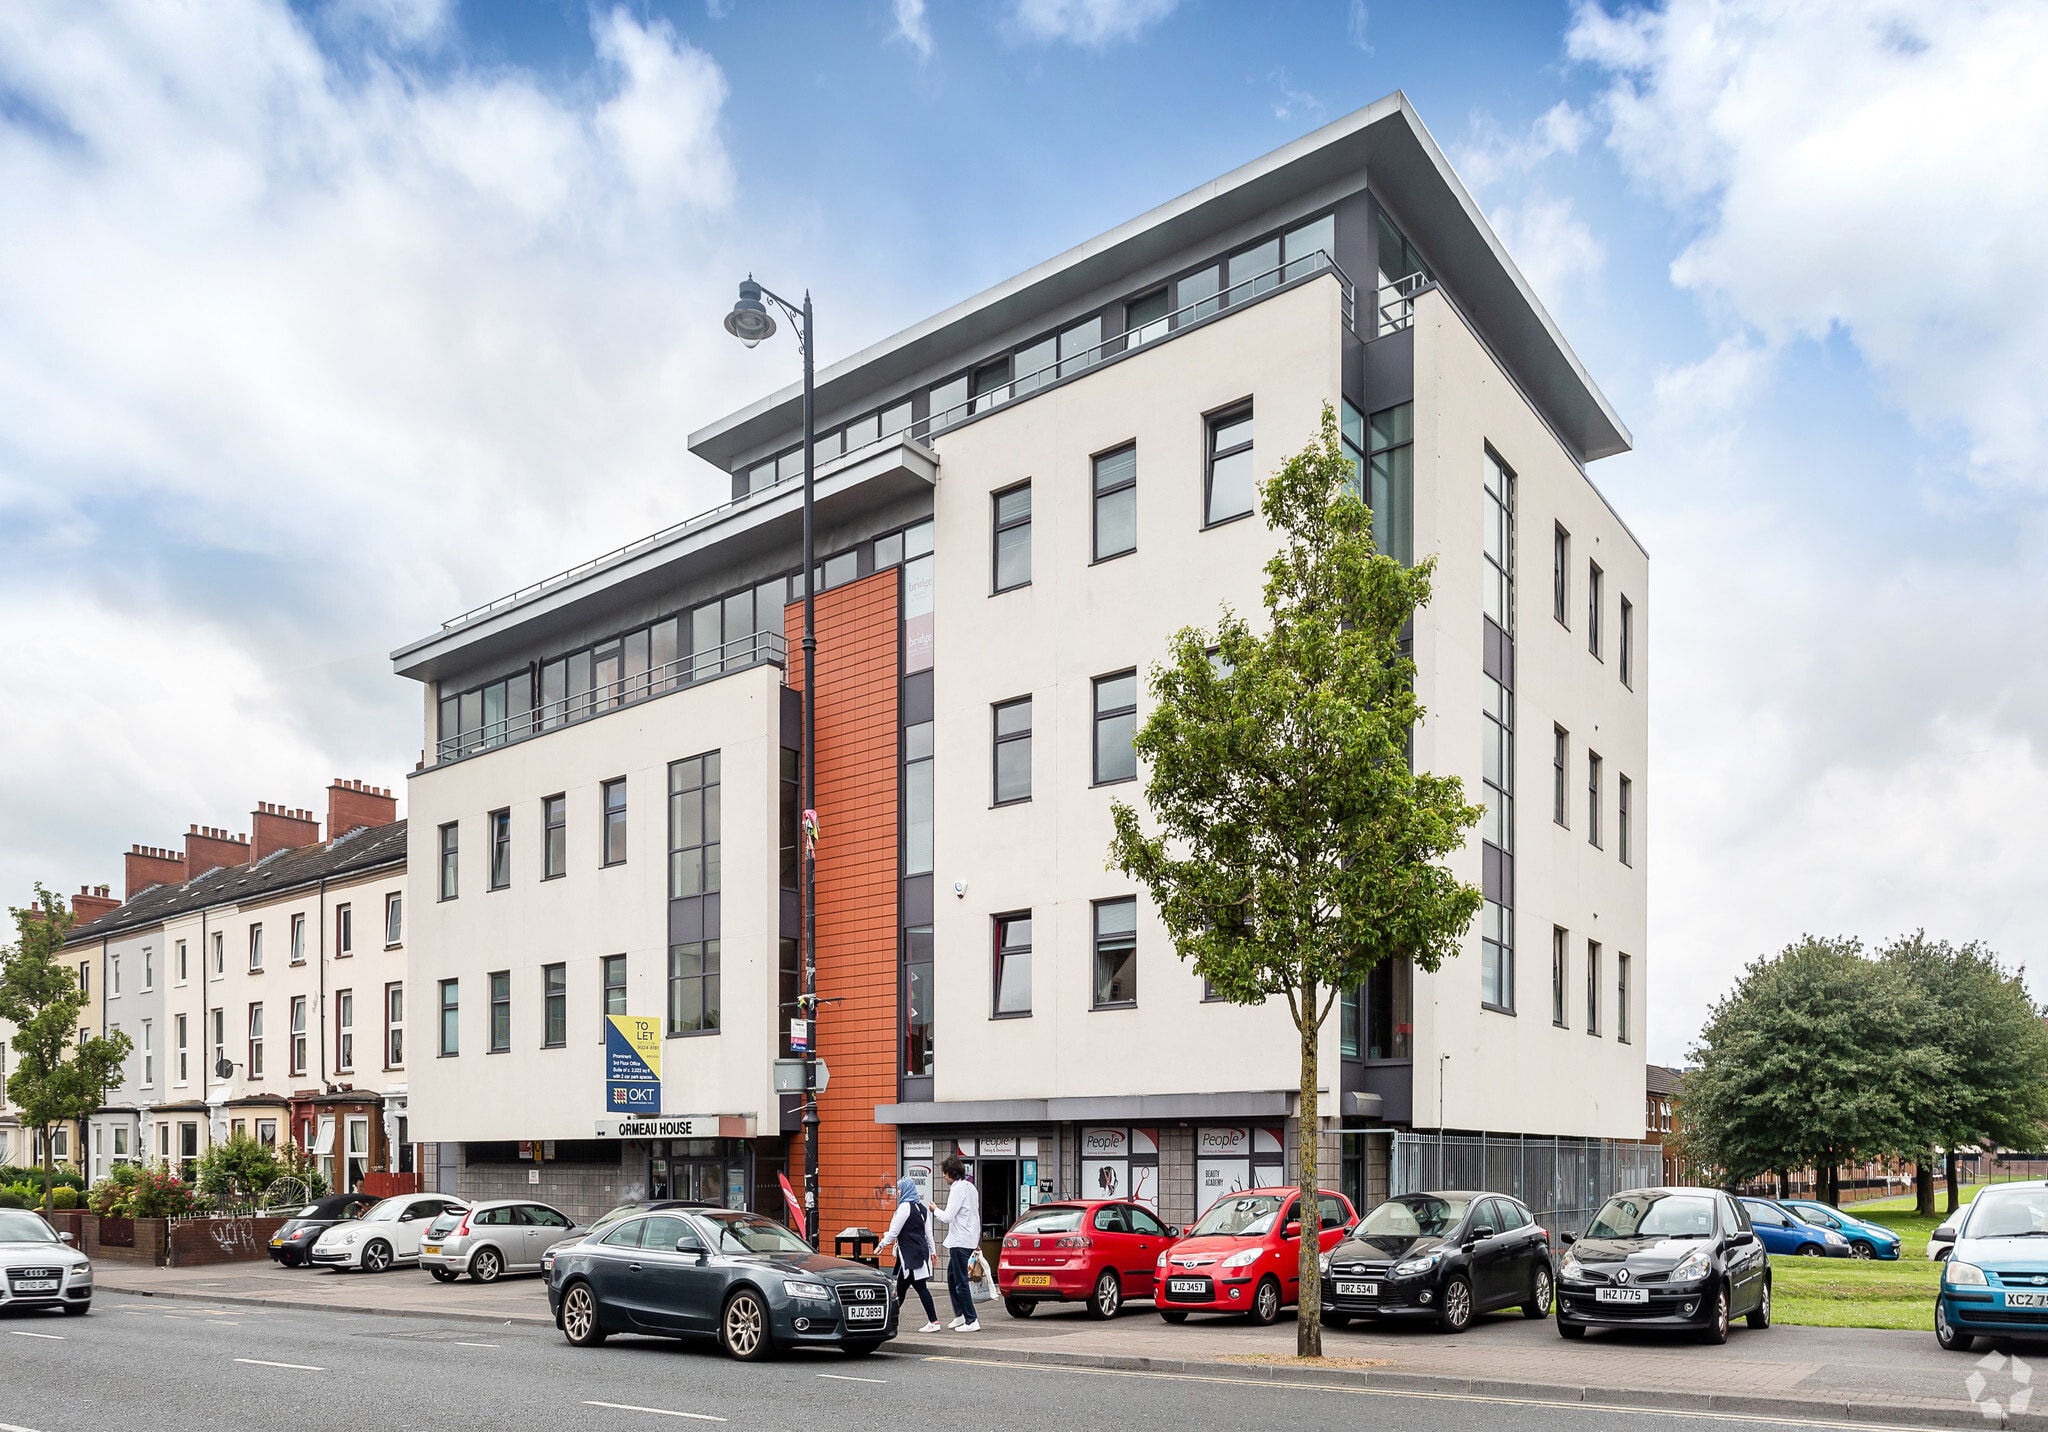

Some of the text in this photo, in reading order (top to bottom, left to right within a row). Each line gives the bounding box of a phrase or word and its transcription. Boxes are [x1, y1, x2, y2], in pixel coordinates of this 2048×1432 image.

[635, 1021, 648, 1031] TO
[637, 1032, 654, 1041] LET
[629, 1088, 655, 1101] OKT
[618, 1121, 692, 1136] ORMEAU HOUSE
[980, 1137, 1009, 1148] People
[1087, 1134, 1120, 1151] People
[1203, 1131, 1240, 1149] People
[1205, 1170, 1220, 1178] BEAUTY
[1205, 1179, 1223, 1187] ACADEMY
[1021, 1276, 1031, 1284] KIG
[1173, 1282, 1203, 1291] VJZ 3457
[1340, 1284, 1374, 1294] DRZ 5341
[1603, 1289, 1641, 1300] IHZ 1775
[2007, 1293, 2034, 1306] XCZ
[851, 1307, 865, 1318] RJZ
